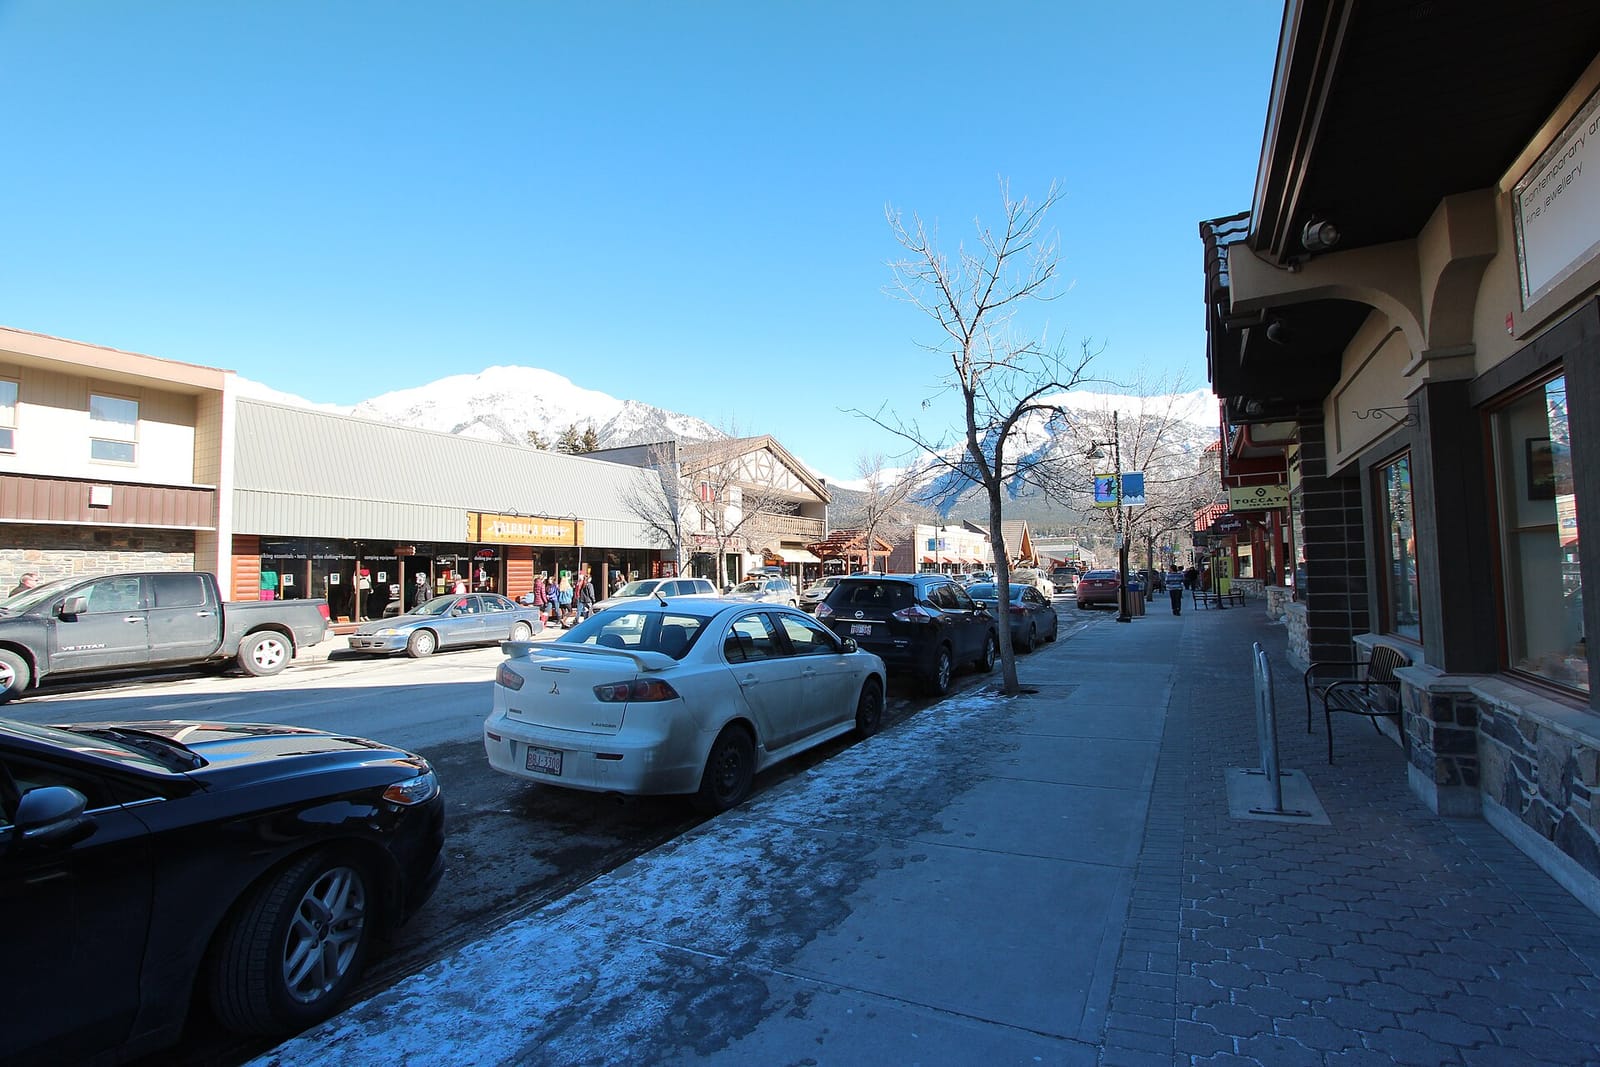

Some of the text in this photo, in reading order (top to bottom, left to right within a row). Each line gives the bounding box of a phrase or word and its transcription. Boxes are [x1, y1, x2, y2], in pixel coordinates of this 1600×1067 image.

[1524, 133, 1586, 208] contemporary
[1543, 161, 1583, 213] jewellery
[1233, 496, 1289, 505] TOCCATA
[489, 520, 539, 537] VALHALLA
